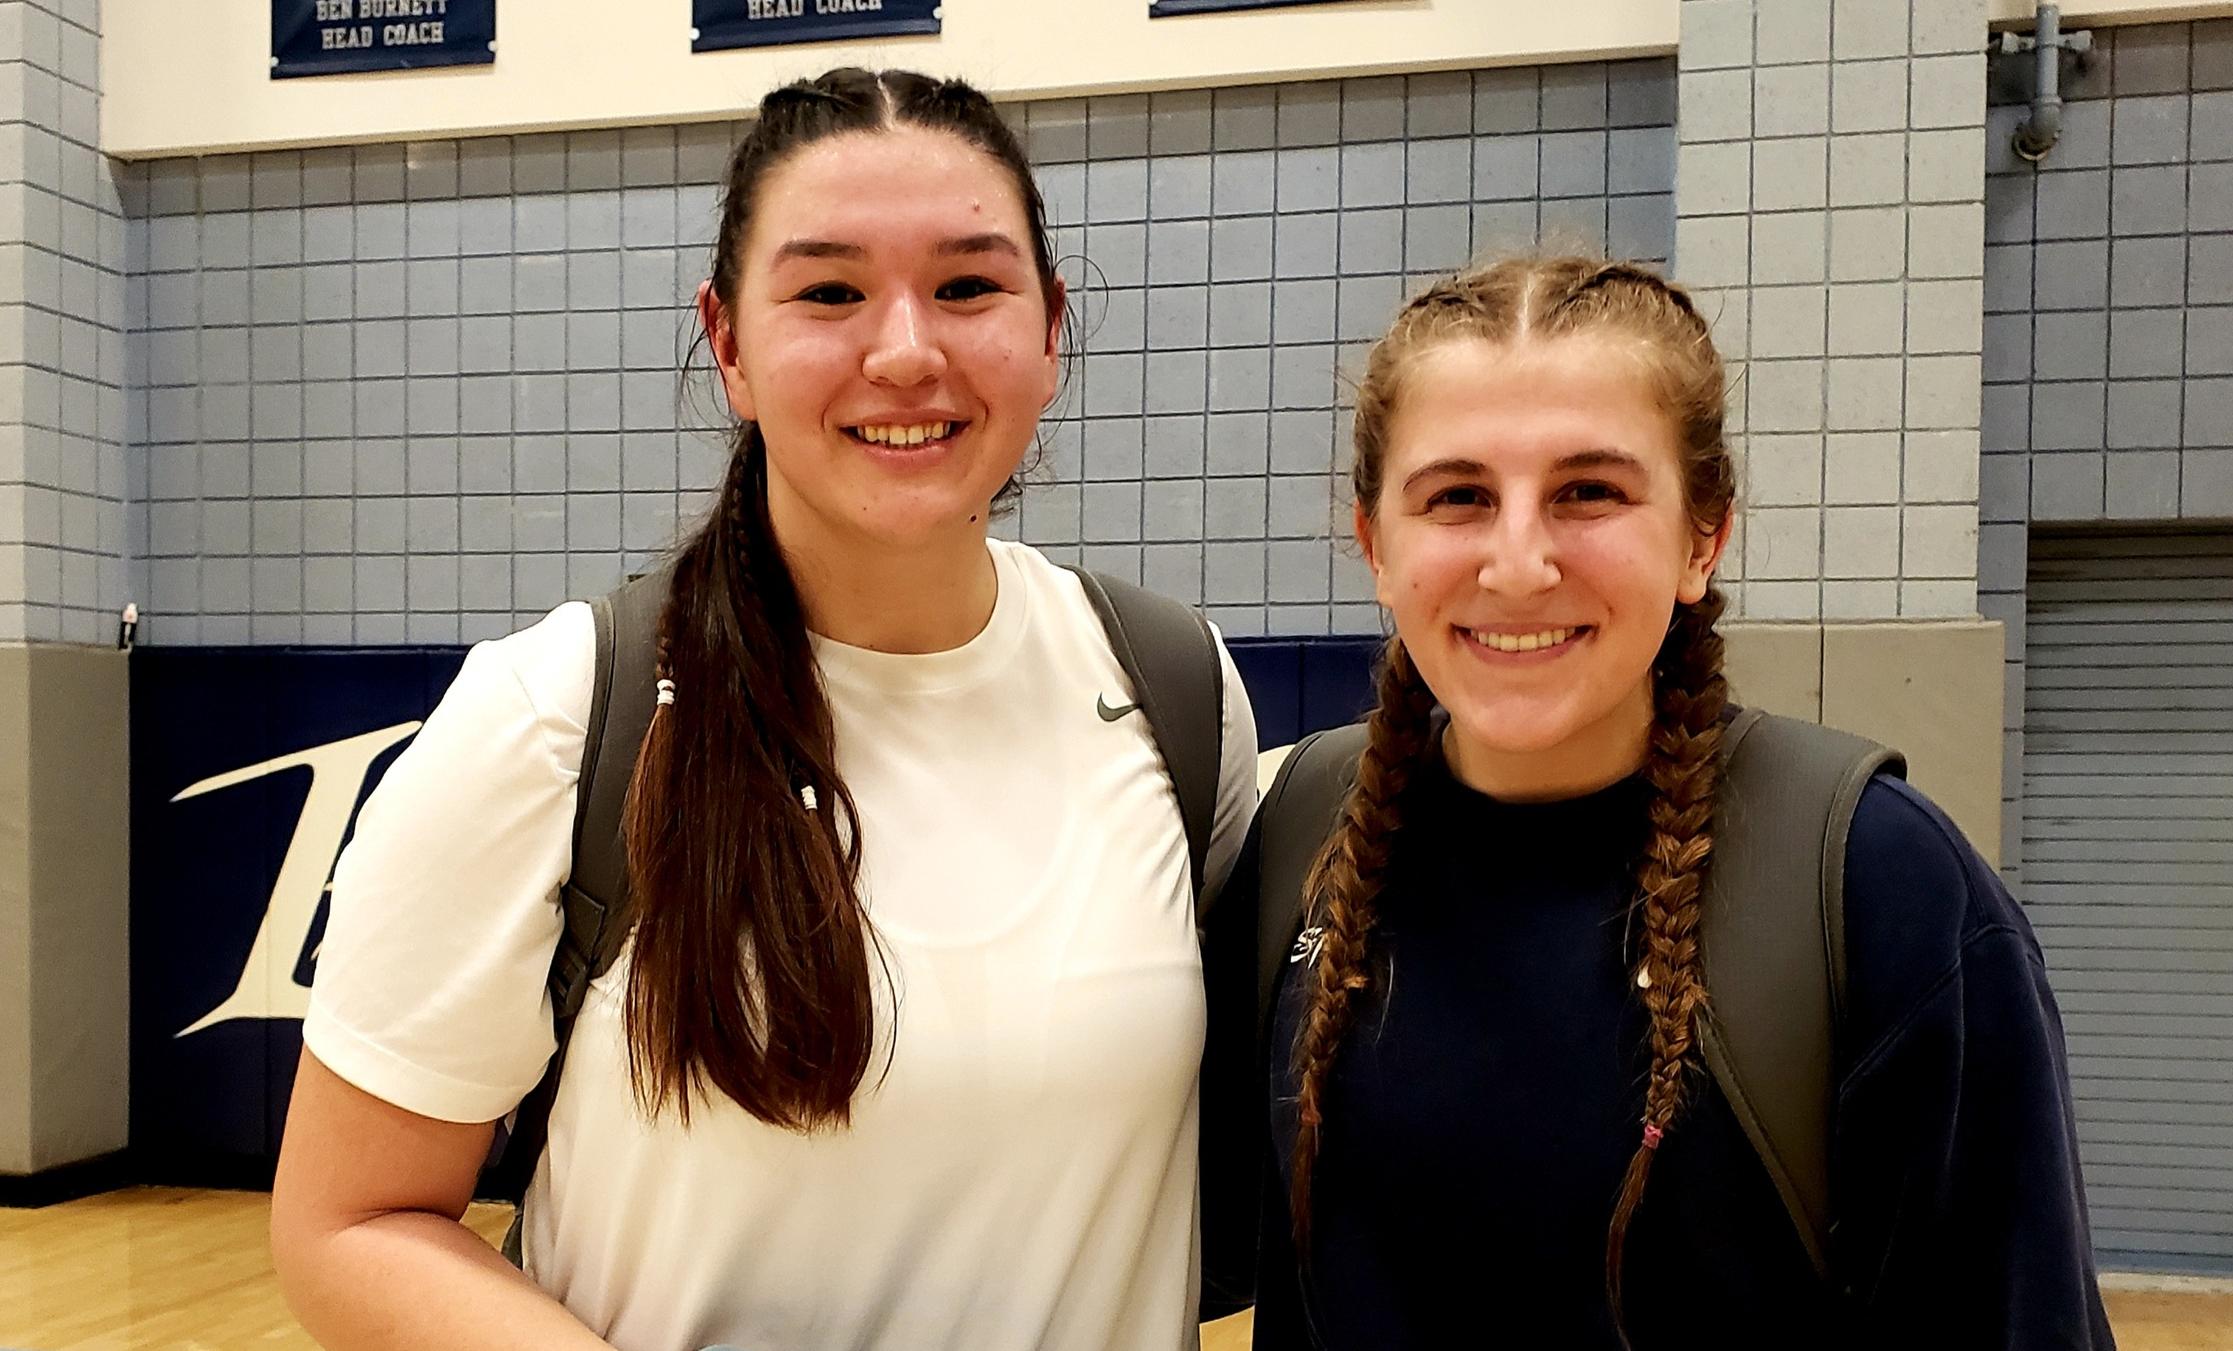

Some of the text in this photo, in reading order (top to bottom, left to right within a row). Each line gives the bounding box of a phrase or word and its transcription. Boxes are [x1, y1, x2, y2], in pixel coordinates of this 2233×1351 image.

[316, 0, 446, 21] BEN BURNETT
[747, 0, 804, 19] HEAD
[321, 21, 444, 49] HEAD COACH
